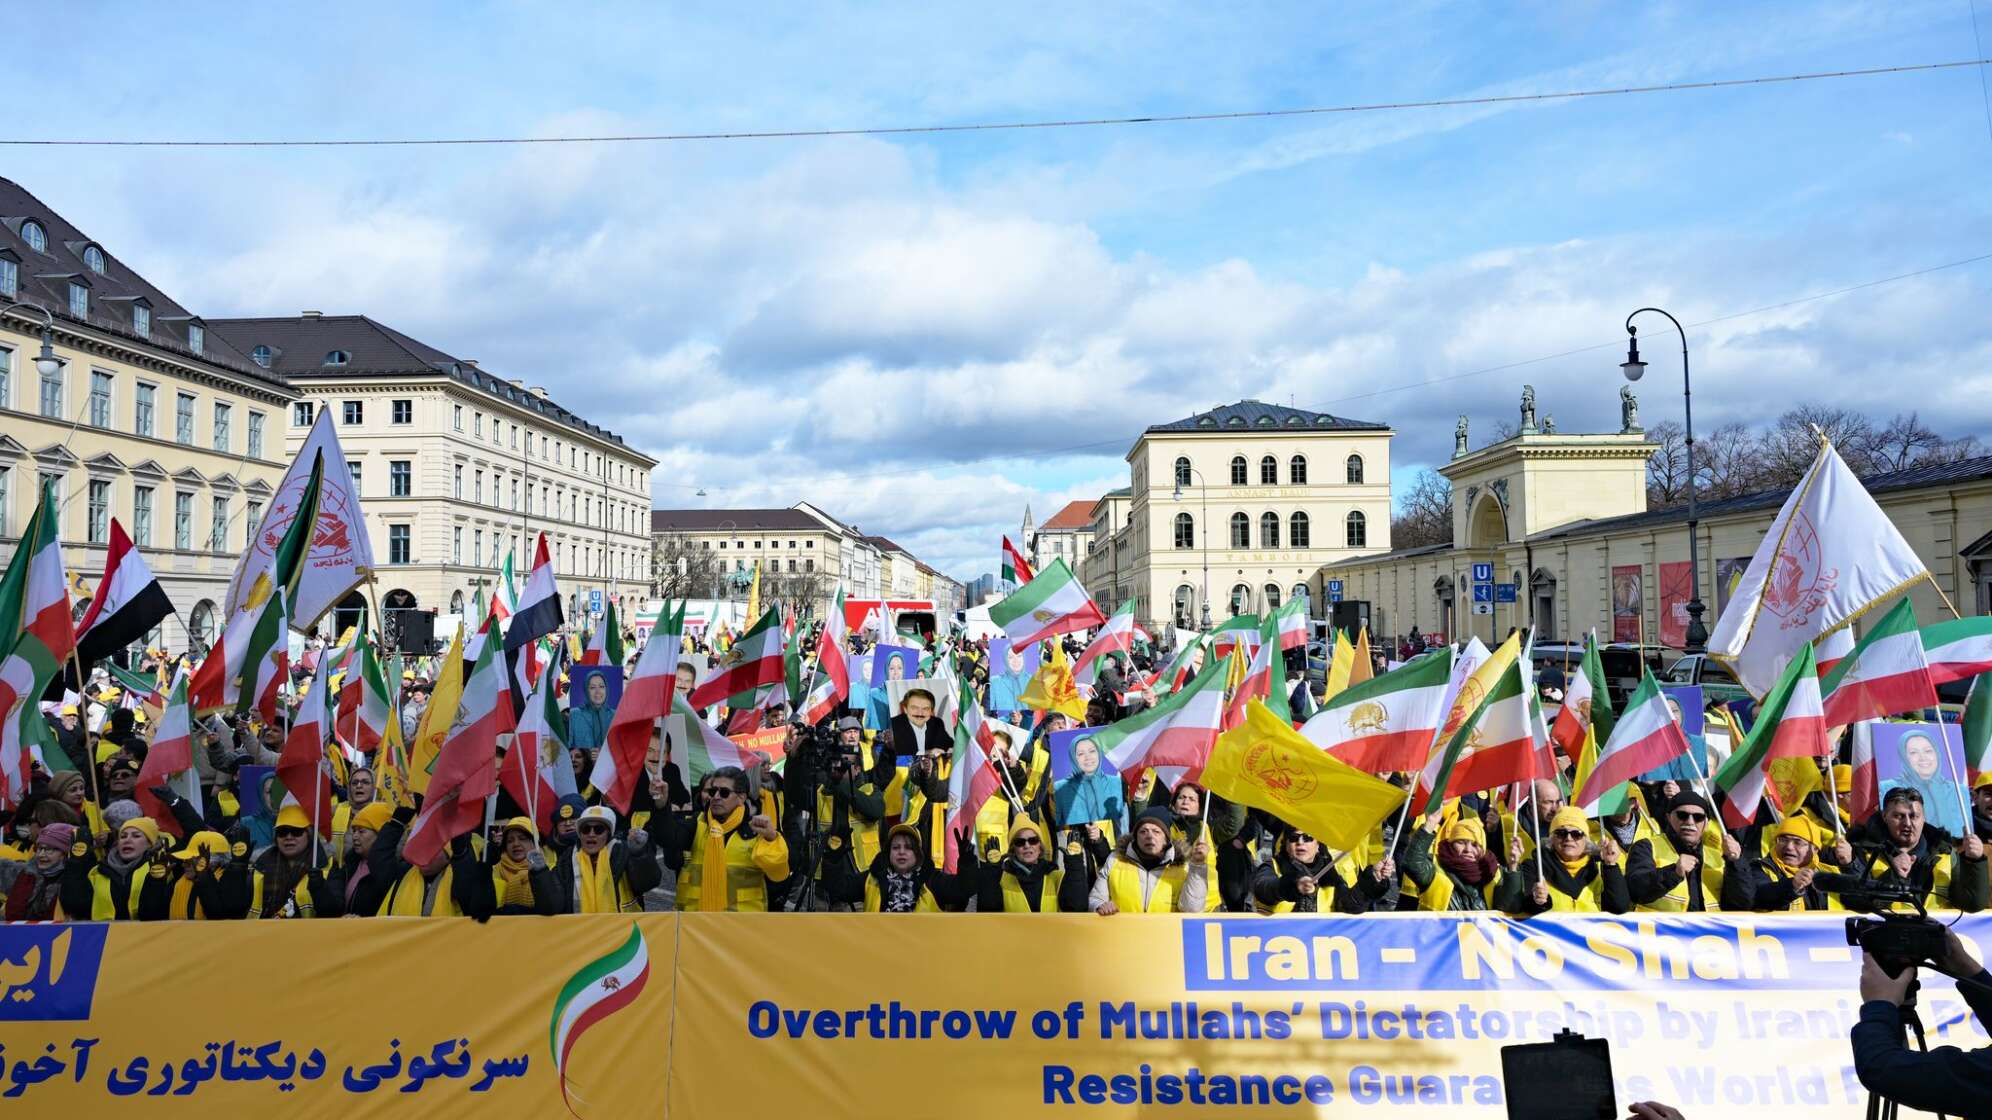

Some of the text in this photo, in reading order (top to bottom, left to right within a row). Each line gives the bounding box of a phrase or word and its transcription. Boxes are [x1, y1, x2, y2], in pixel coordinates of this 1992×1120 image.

[1331, 581, 1339, 591] U
[1476, 566, 1488, 580] U
[1206, 924, 1357, 979] Iran
[1459, 922, 1564, 981] No
[1586, 922, 1790, 981] Shah
[748, 1000, 1016, 1040] Overthrow
[1032, 1001, 1084, 1040] of
[1320, 1000, 1645, 1049] Dictatorship
[1655, 1000, 1719, 1050] by
[108, 1040, 326, 1096] دیکتاتوری
[344, 1039, 529, 1093] سرنگونی
[1043, 1064, 1334, 1105] Resistance
[1666, 1063, 1830, 1106] World
